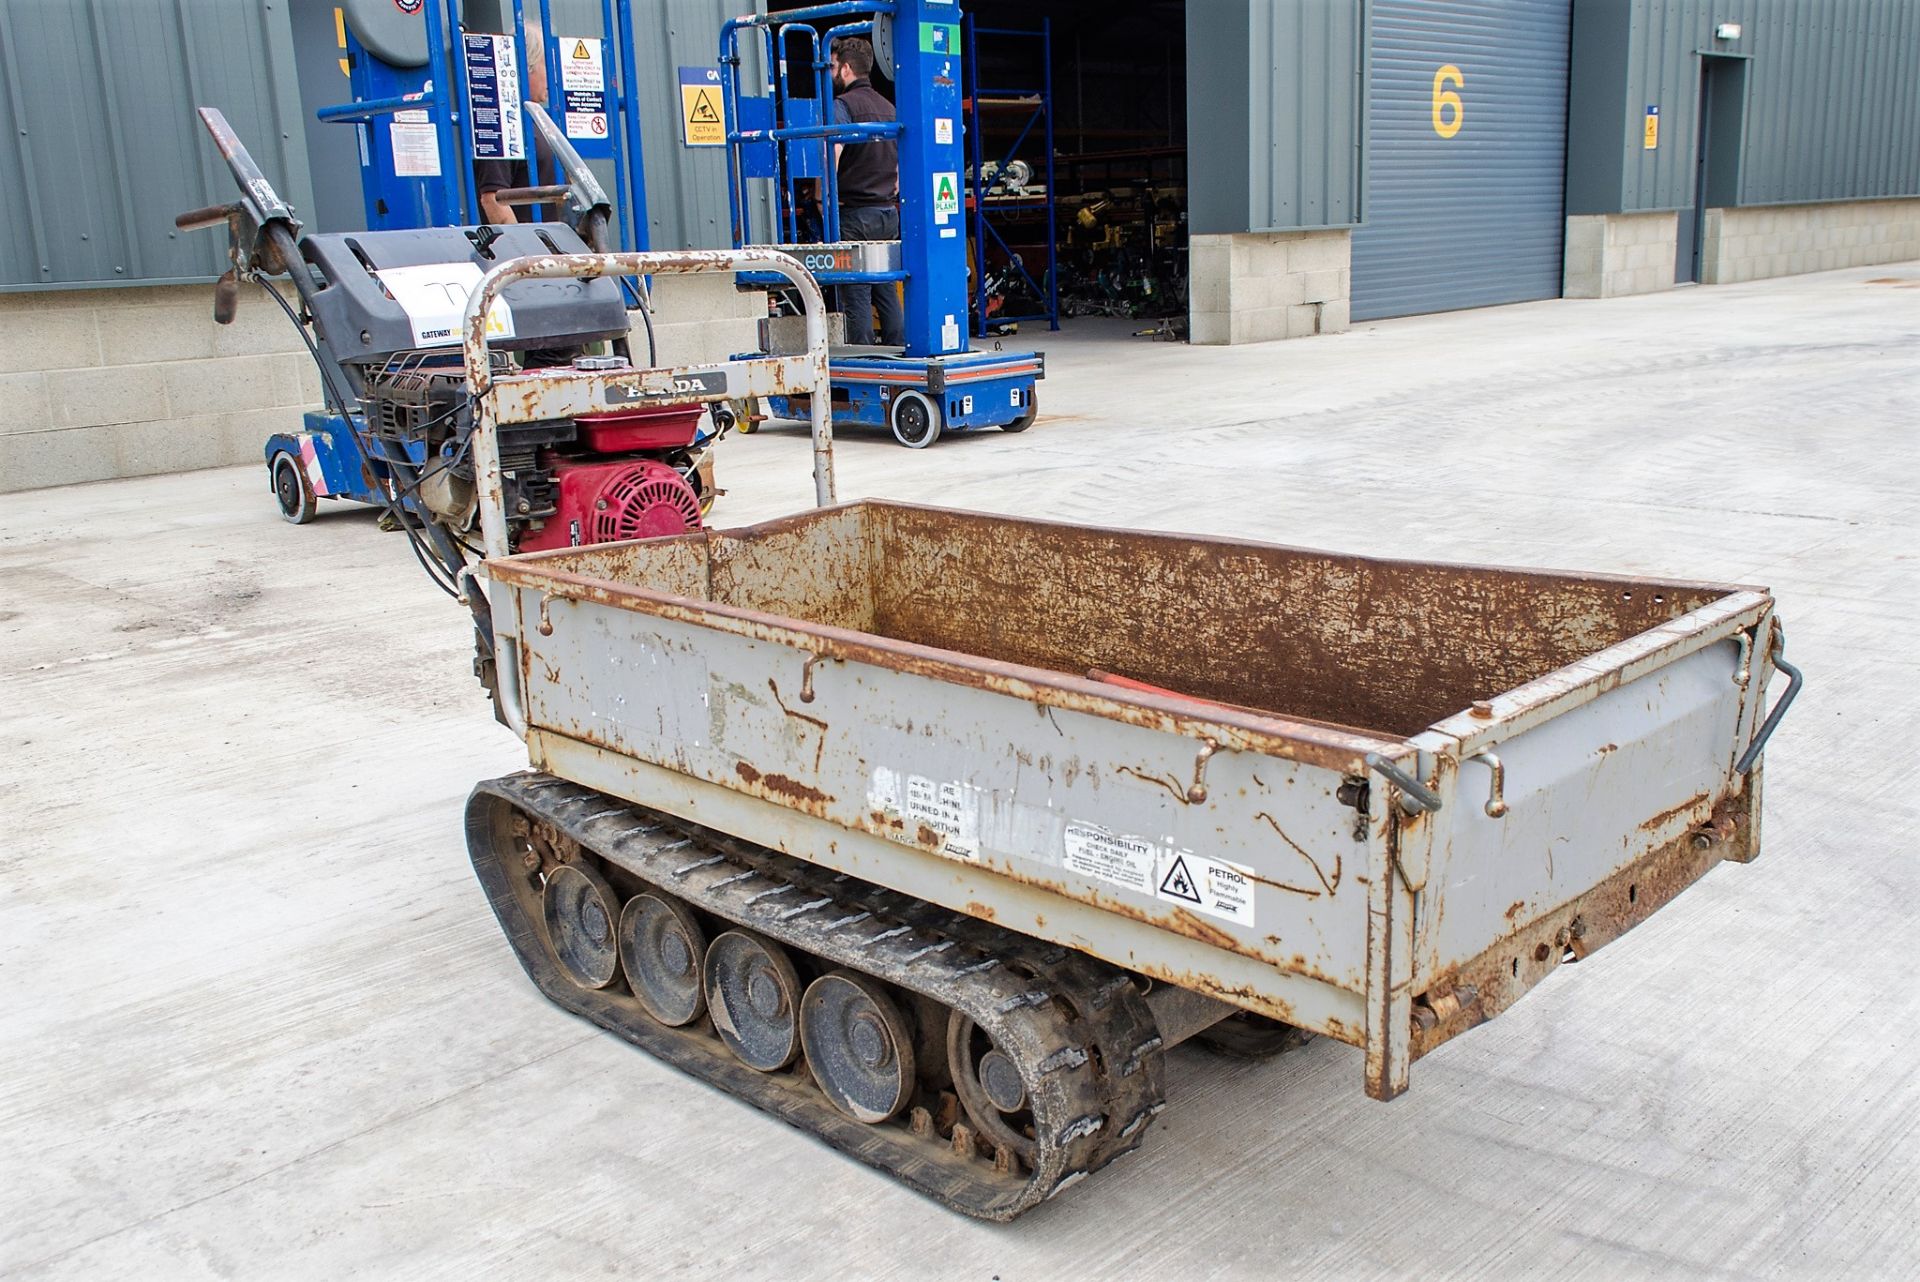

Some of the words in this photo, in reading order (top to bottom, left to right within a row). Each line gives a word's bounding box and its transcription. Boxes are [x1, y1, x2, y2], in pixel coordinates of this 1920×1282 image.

[1432, 64, 1465, 139] 6
[936, 176, 955, 201] A
[935, 201, 957, 211] PLANT
[804, 250, 853, 271] ecolift
[421, 328, 451, 340] GATEWAY
[626, 378, 707, 398] HDA
[1067, 827, 1149, 855] RESPONSIBILITY
[1086, 841, 1108, 853] CHECK
[1109, 847, 1129, 859] DAILY
[1078, 847, 1095, 857] FUEL
[1208, 866, 1248, 886] PETROL
[1208, 888, 1247, 905] Flammable
[1217, 880, 1239, 894] Highly
